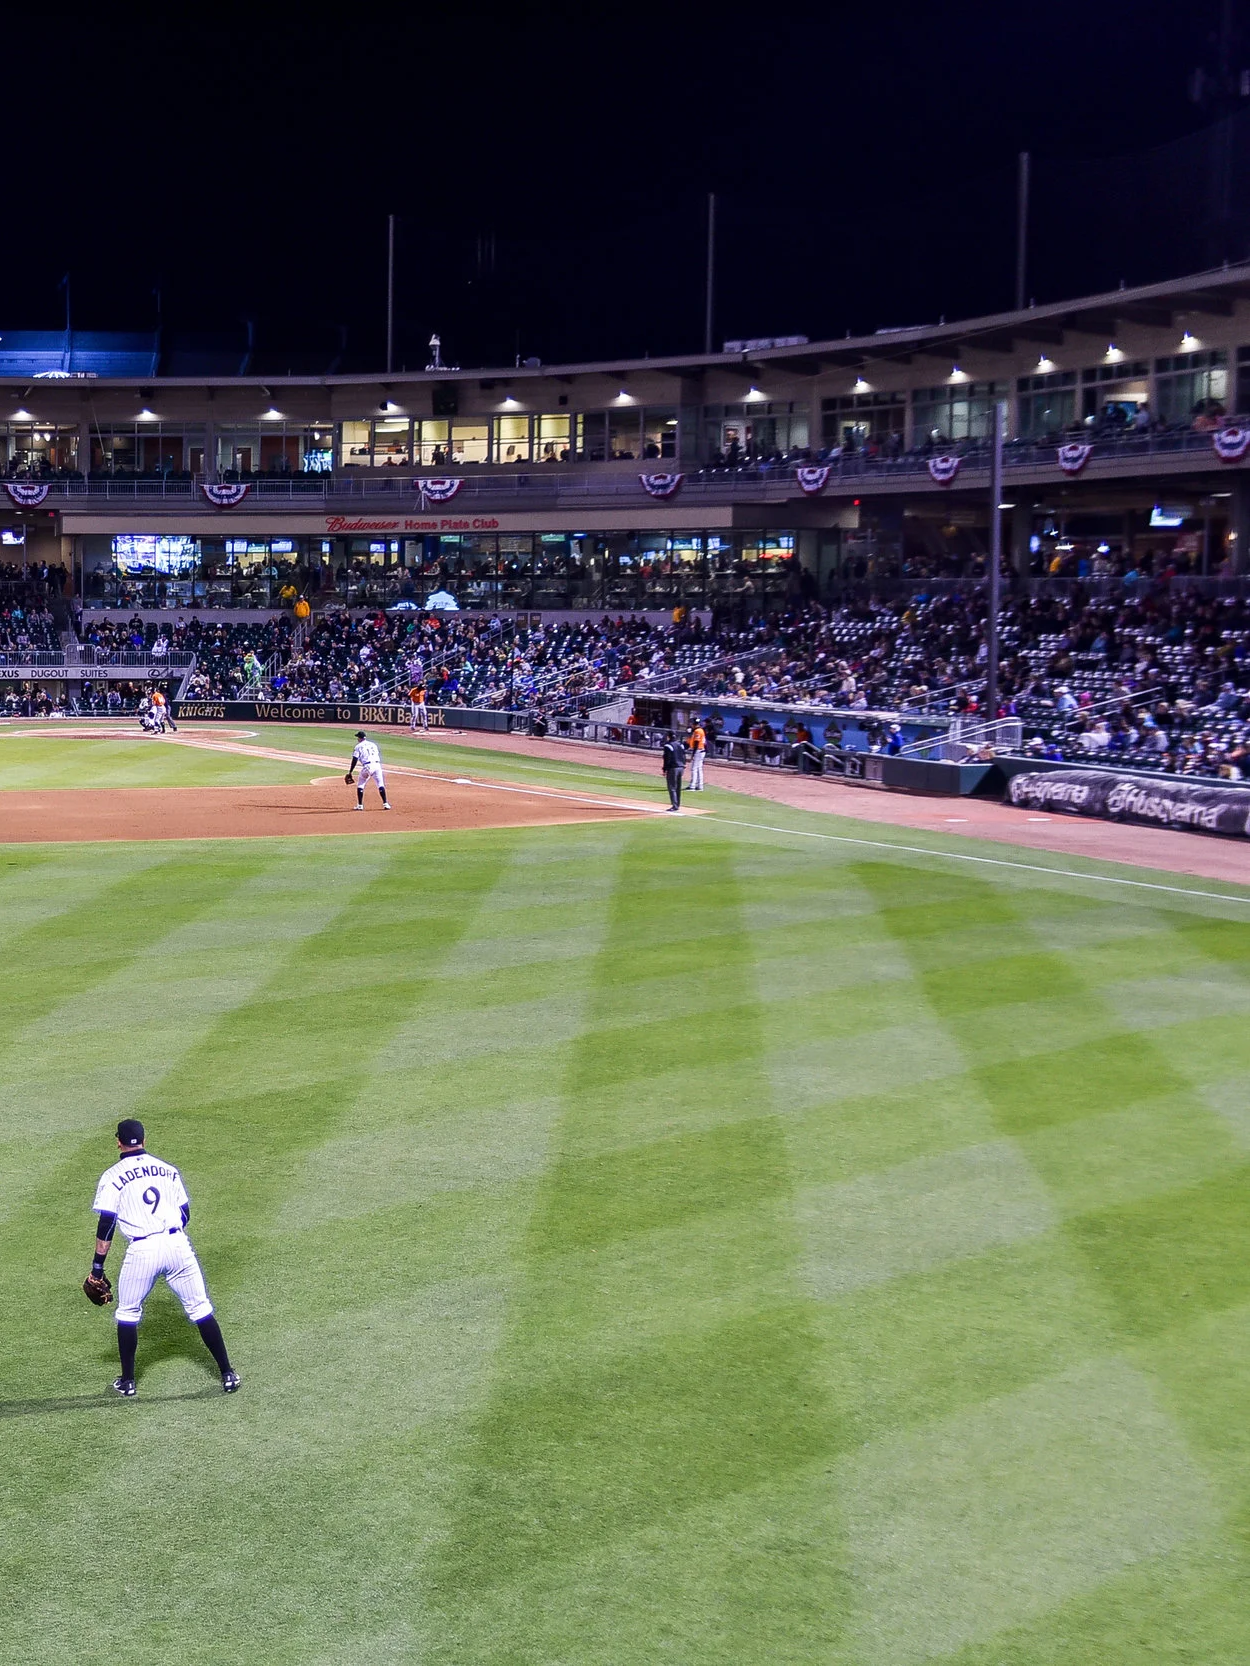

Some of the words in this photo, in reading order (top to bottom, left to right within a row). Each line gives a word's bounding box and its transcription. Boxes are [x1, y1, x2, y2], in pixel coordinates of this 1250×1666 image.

[325, 516, 400, 532] Budweiser
[404, 519, 437, 530] Home
[440, 519, 470, 530] Plate
[472, 518, 499, 529] Club
[30, 669, 69, 678] DUGOUT
[80, 669, 108, 678] SUITES
[177, 706, 226, 718] KNIGHTS
[255, 703, 325, 719] Welcome
[336, 706, 351, 720] to
[359, 706, 395, 723] BB&T
[1126, 785, 1229, 830] Husqvarna
[142, 1186, 161, 1215] 9
